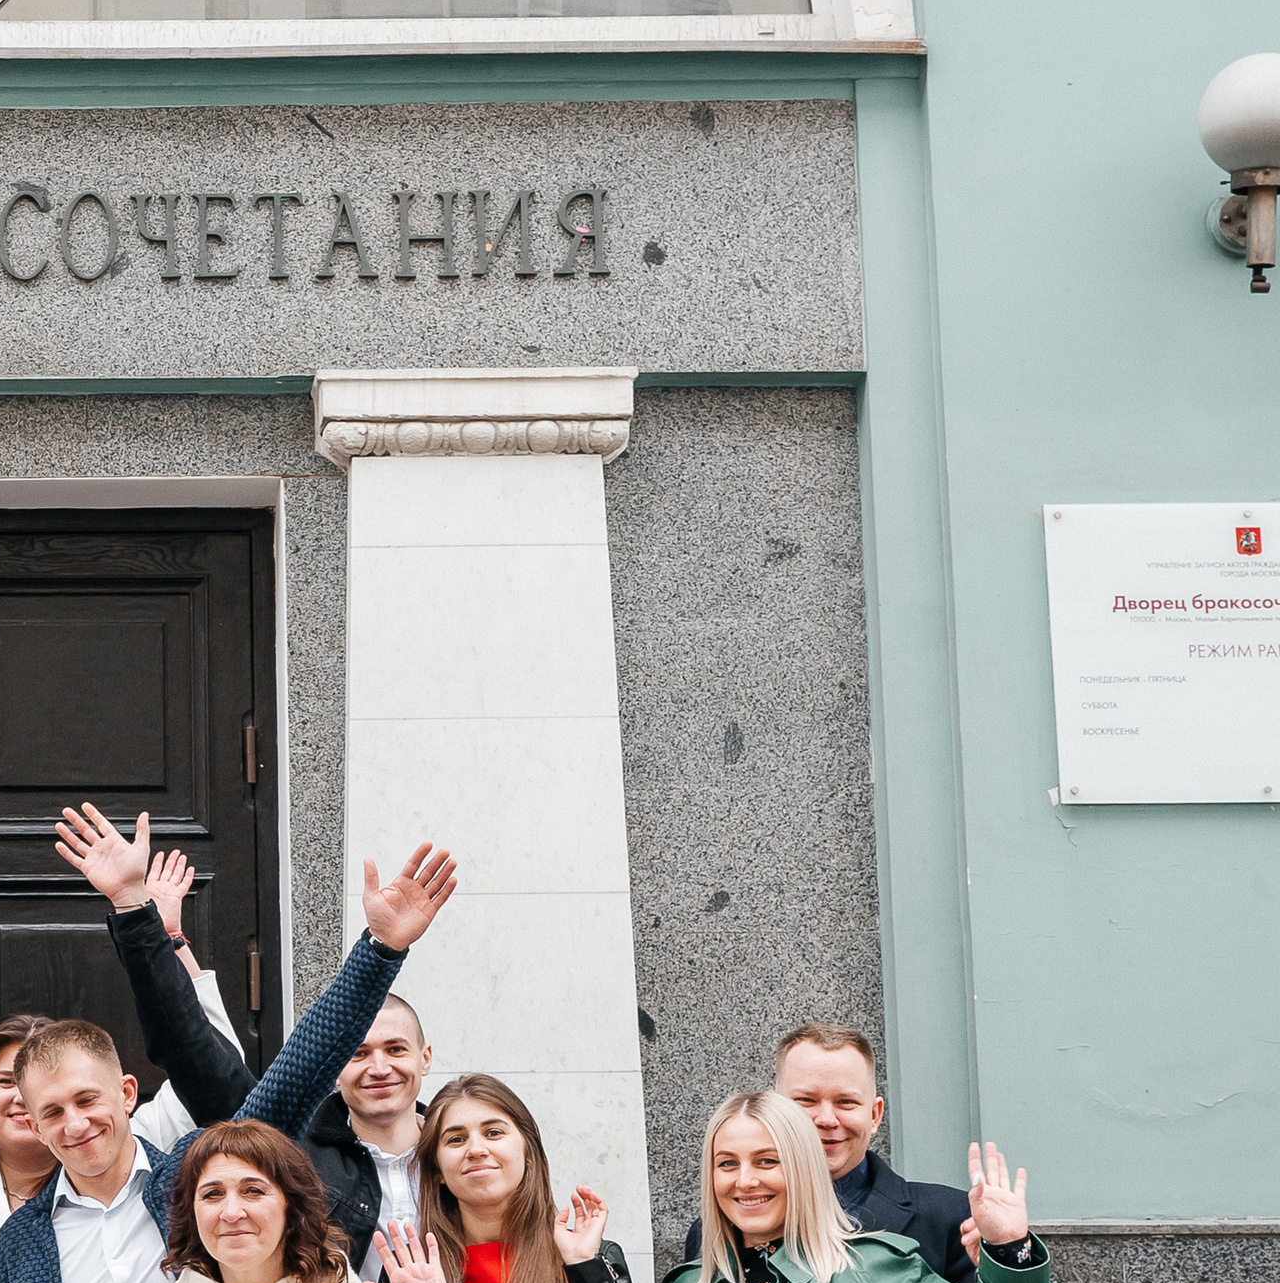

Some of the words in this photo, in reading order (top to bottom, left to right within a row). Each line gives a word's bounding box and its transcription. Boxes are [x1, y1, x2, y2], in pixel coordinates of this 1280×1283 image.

[1251, 561, 1280, 569] ГРАЖДА
[1220, 570, 1249, 578] ГОРОДА
[1112, 595, 1187, 614] Дворец
[1188, 644, 1253, 659] РЕЖИМ
[1258, 643, 1280, 658] РА
[1079, 676, 1142, 684] ПОНЕДЕЛЬНИК
[1148, 675, 1187, 684] ПЯТНИЦА
[1081, 702, 1118, 710] СУББОТА
[1082, 728, 1140, 736] ВОСКРЕСЕНЬЕ
